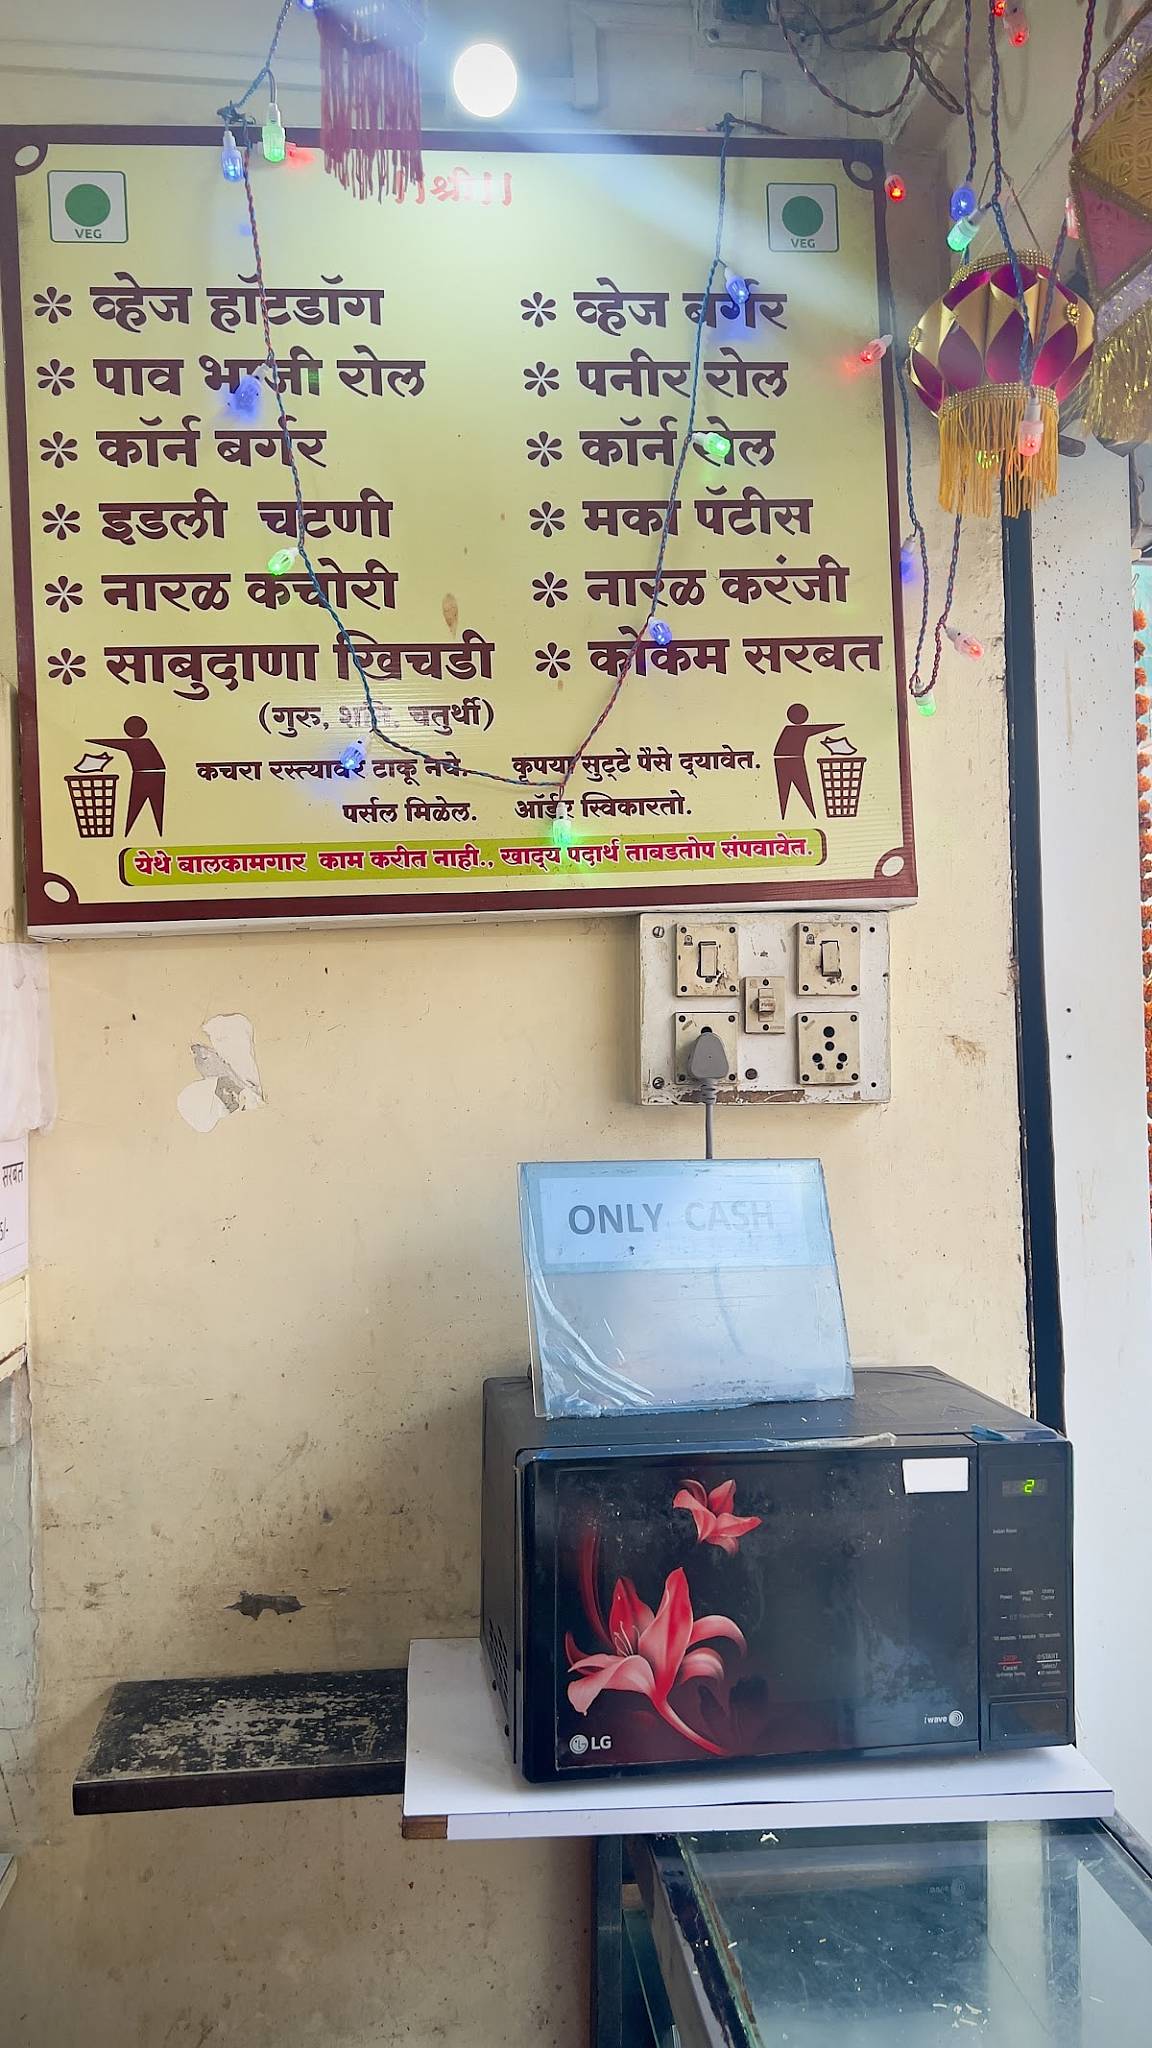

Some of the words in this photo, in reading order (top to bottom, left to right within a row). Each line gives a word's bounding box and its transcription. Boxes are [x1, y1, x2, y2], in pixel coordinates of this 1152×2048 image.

[75, 228, 102, 240] VEG
[790, 238, 816, 249] VEG
[89, 271, 193, 334] व्हेज
[206, 274, 385, 334] हॉटडॉग
[572, 276, 670, 336] व्हेज
[682, 278, 788, 330] बर्गर
[92, 358, 185, 396] पाव
[336, 344, 426, 397] रोल
[576, 347, 691, 398] पनीर
[703, 347, 789, 398] रोल
[95, 415, 201, 467] कॉर्न
[214, 415, 327, 468] बर्गर
[578, 416, 678, 467] कॉर्न
[98, 487, 229, 545] इडली
[257, 487, 394, 538] चटणी
[582, 499, 682, 538] मका
[694, 485, 814, 536] पॅटीस
[101, 573, 231, 612] नारळ
[244, 557, 399, 611] कचोरी
[584, 569, 707, 608] नारळ
[719, 553, 850, 603] करंजी
[103, 643, 320, 700] साबुदाणा
[332, 629, 496, 680] खिचडी
[587, 625, 731, 677] कोकम
[741, 636, 884, 674] सरबत
[407, 696, 495, 736] चतुर्थी)
[196, 761, 263, 781] कचरा
[371, 758, 421, 786] टाकू
[511, 756, 574, 784] कृपया
[636, 746, 673, 772] पैसे
[342, 796, 399, 824] पर्सल
[404, 795, 477, 824] मिळेल.
[581, 789, 692, 817] स्विकारतो.
[134, 849, 172, 875] येथे
[177, 851, 307, 875] बालकामगार
[318, 851, 365, 870] काम
[370, 844, 428, 870] करीत
[567, 838, 621, 867] पदार्थ
[720, 832, 814, 859] संपवावेत.
[567, 1202, 663, 1235] ONLY
[684, 1199, 775, 1233] CASH
[1024, 1479, 1035, 1493] 2
[590, 1735, 612, 1750] LG
